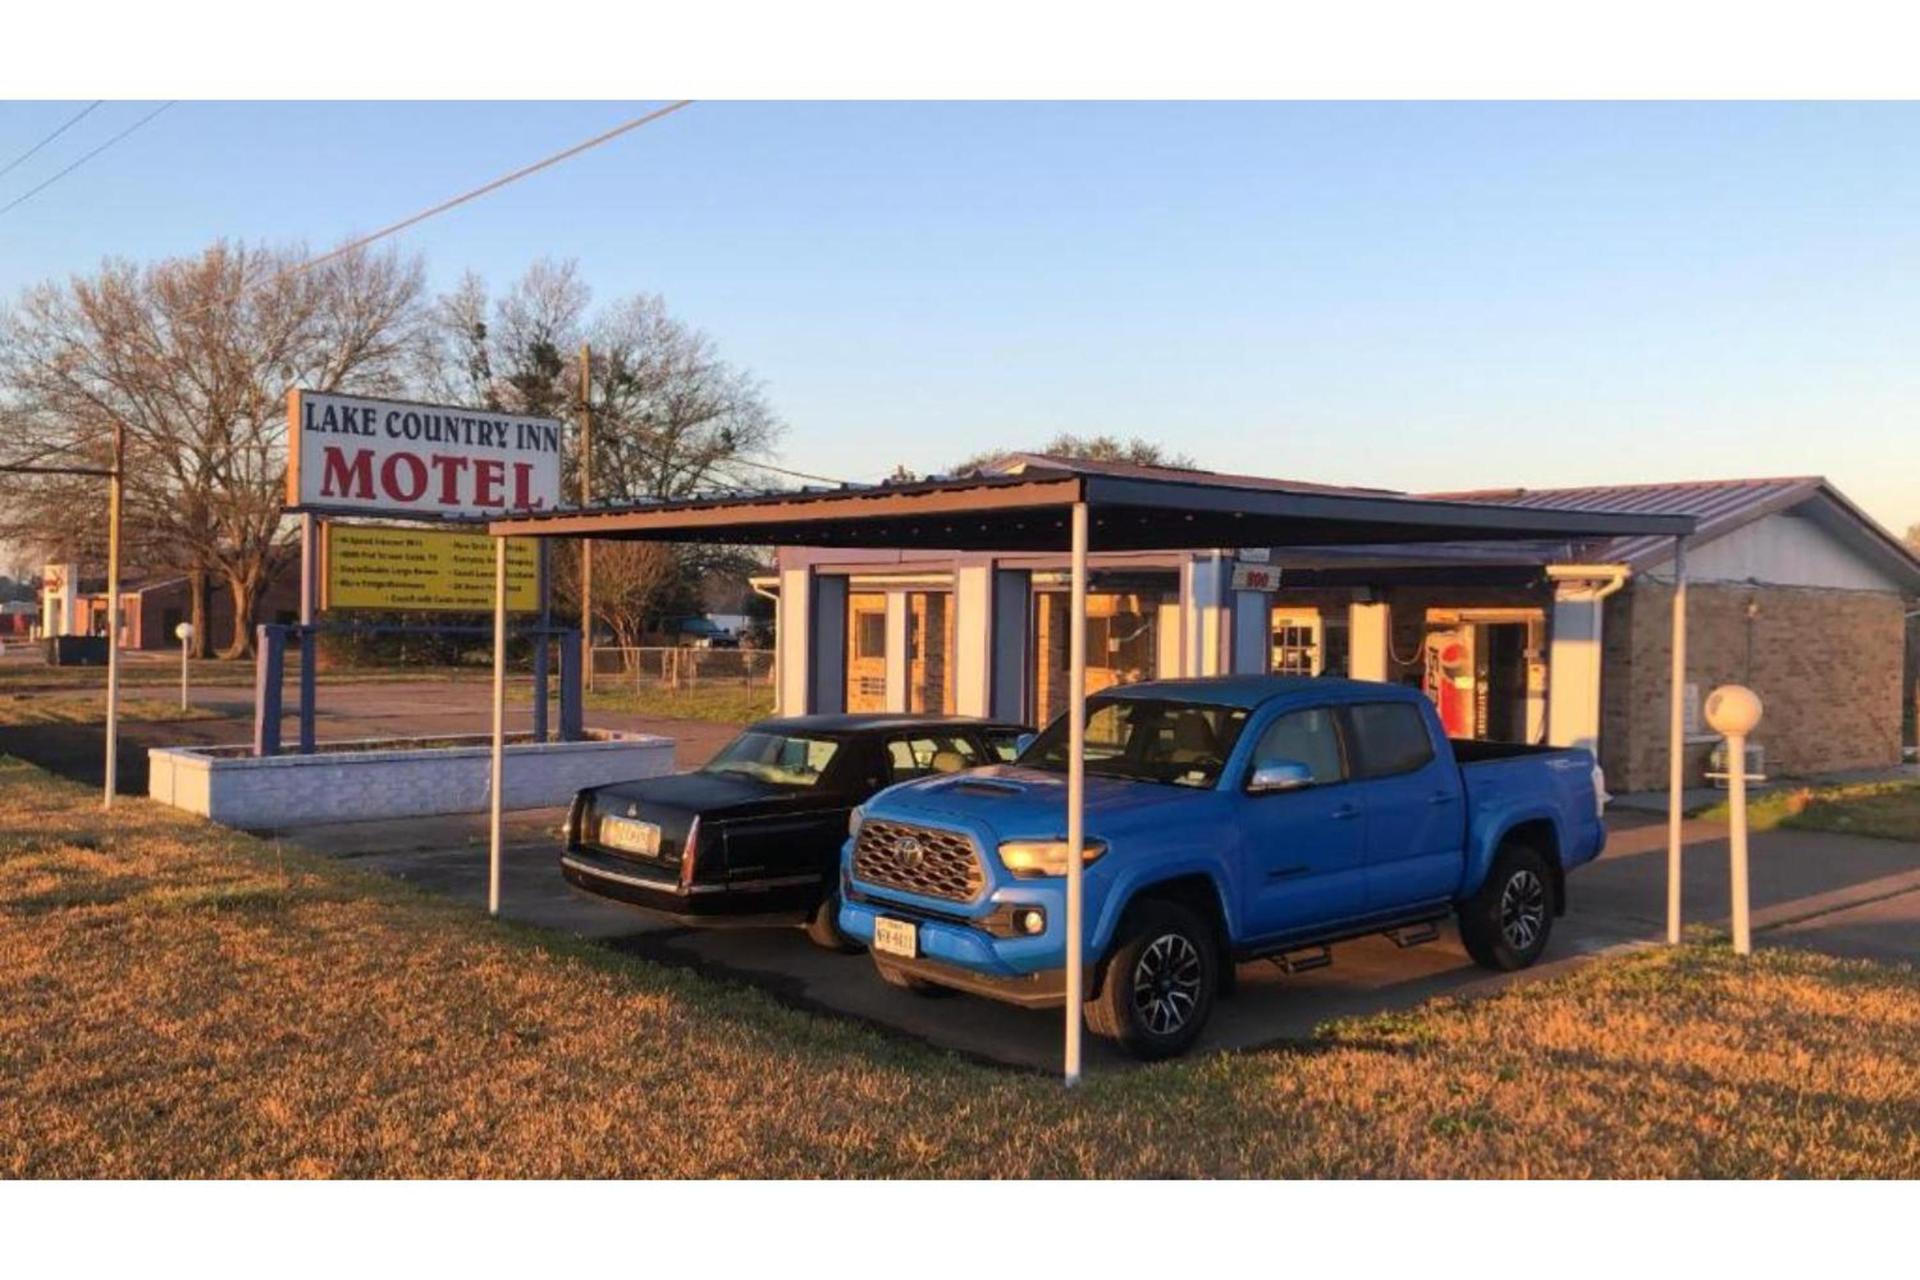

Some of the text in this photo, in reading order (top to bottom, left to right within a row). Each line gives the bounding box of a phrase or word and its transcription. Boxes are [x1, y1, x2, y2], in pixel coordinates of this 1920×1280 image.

[305, 402, 559, 452] LAKE COUNTRY INN
[320, 446, 543, 510] MOTEL
